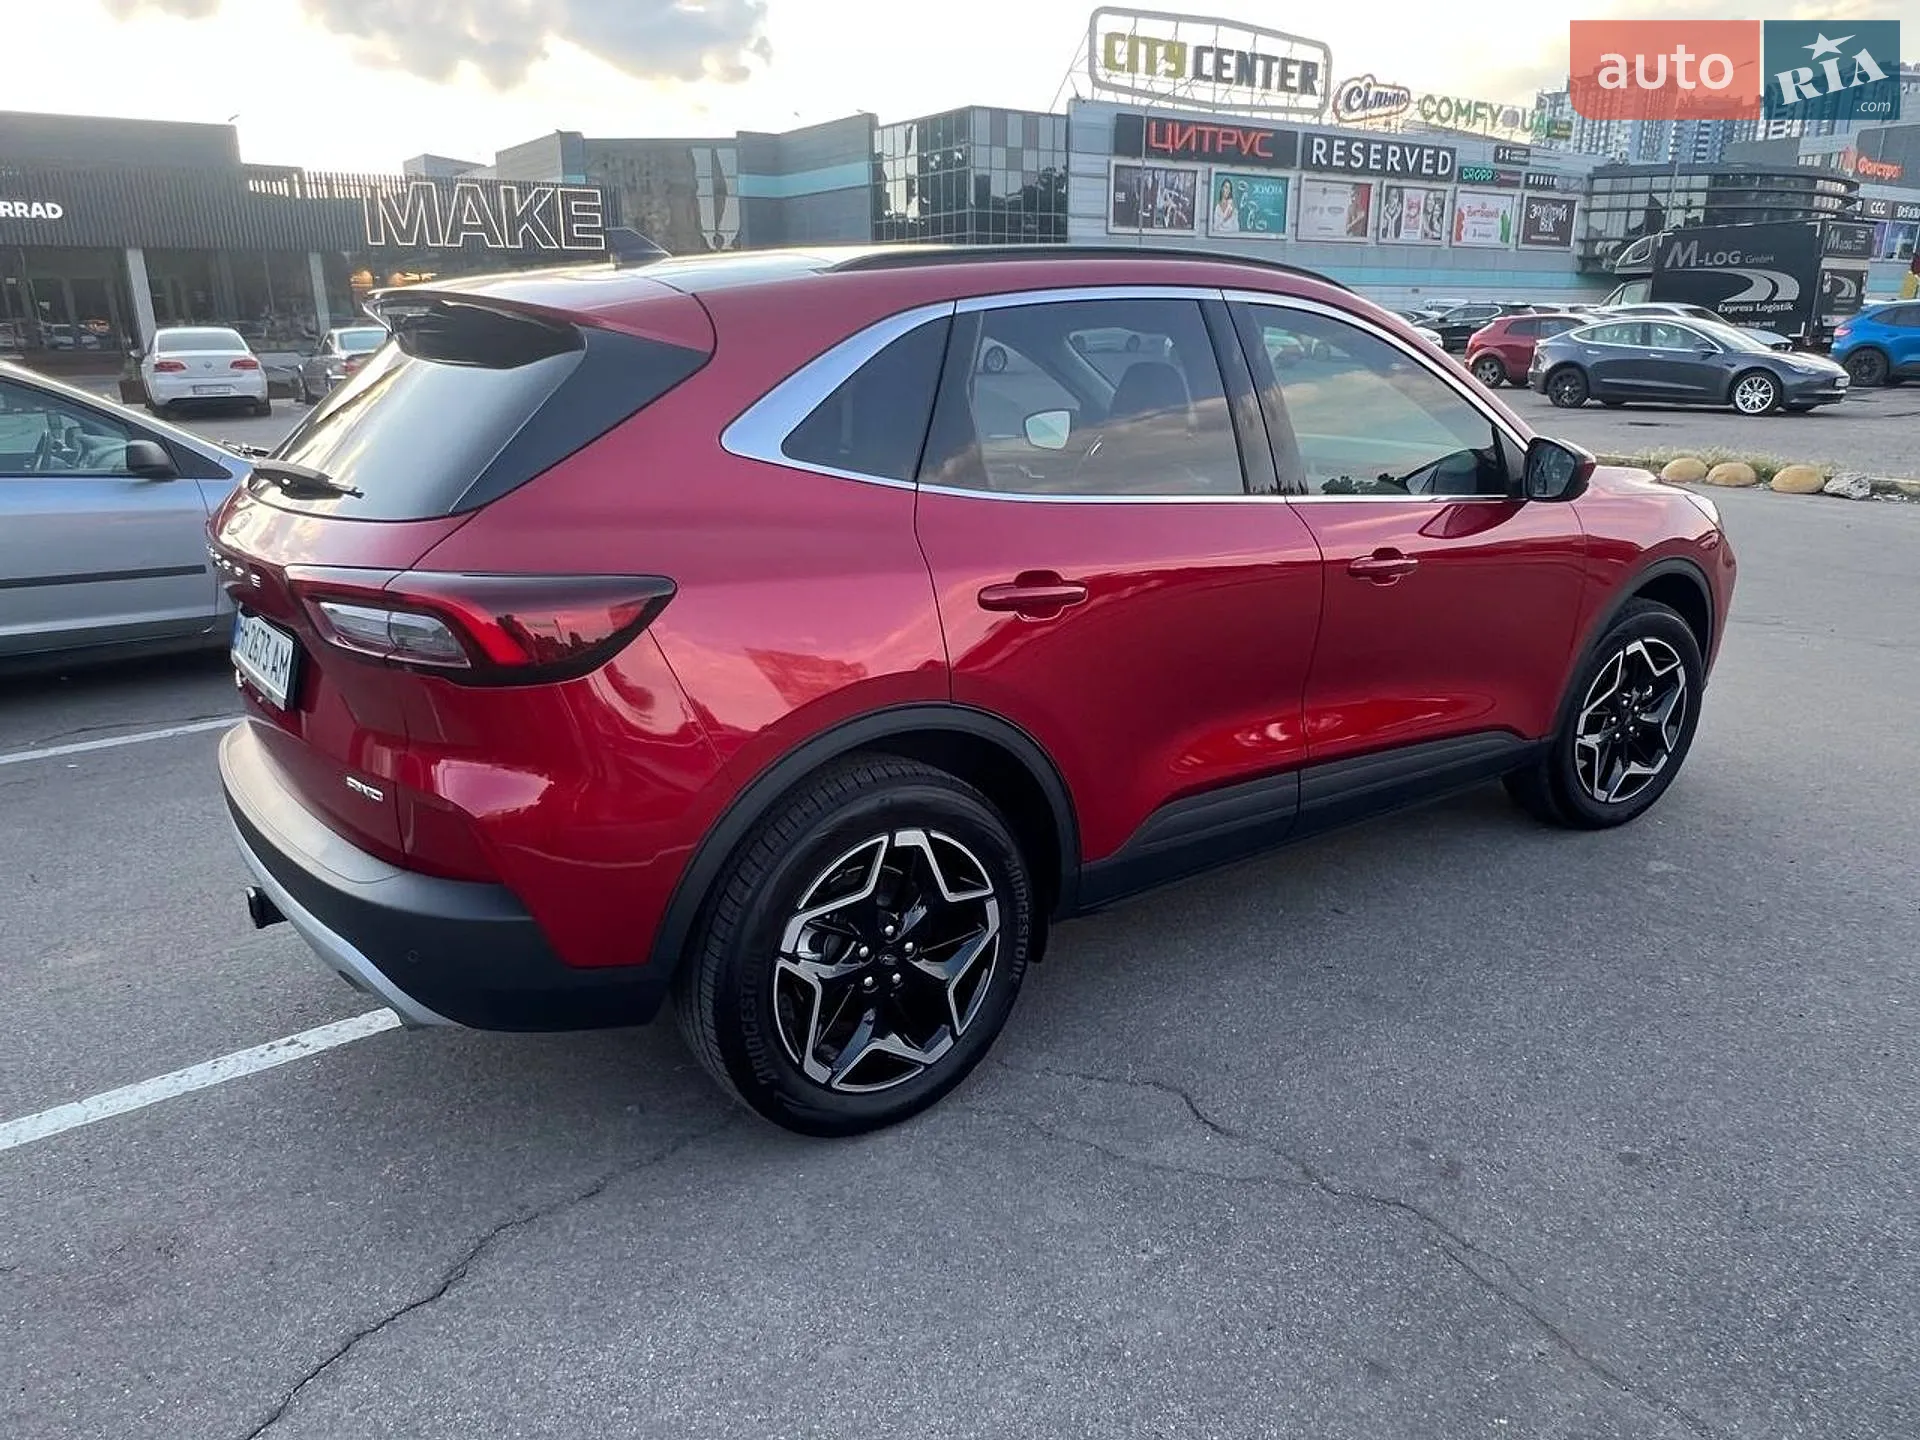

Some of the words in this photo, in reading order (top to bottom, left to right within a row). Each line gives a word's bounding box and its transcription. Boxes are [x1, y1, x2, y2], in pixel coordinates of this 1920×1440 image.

[1103, 31, 1187, 79] CITY
[1192, 45, 1319, 96] CENTER
[1147, 119, 1274, 158] ЦИТРУС
[1311, 137, 1453, 177] RESERVED
[364, 182, 606, 250] MAKE
[1664, 239, 1741, 269] M-LOG
[1717, 303, 1754, 314] Express
[1756, 302, 1794, 313] Logistik
